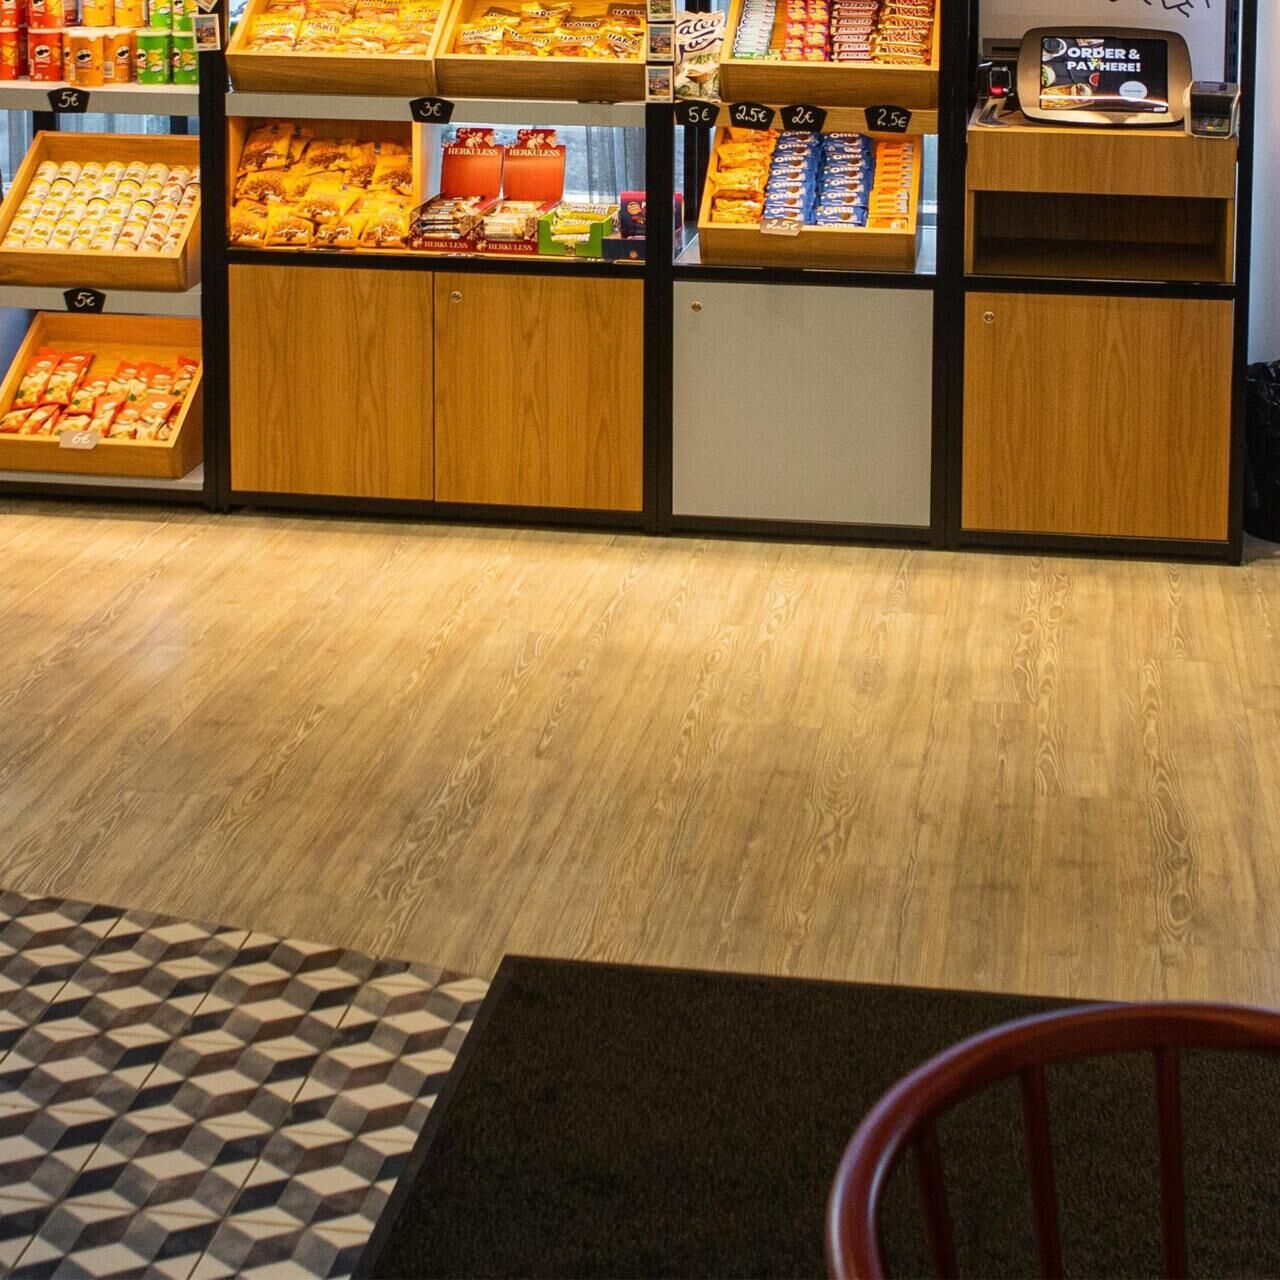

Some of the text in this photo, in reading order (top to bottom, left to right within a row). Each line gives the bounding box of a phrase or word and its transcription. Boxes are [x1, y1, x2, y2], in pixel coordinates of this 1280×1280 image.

[1067, 47, 1141, 60] ORDER &
[1067, 60, 1142, 72] PAY HERE!
[58, 91, 80, 108] 5€
[419, 102, 442, 117] 3€
[688, 107, 709, 122] 5€
[792, 109, 815, 124] 2€
[448, 147, 499, 157] HERKULESS
[509, 148, 561, 157] HERKULESS
